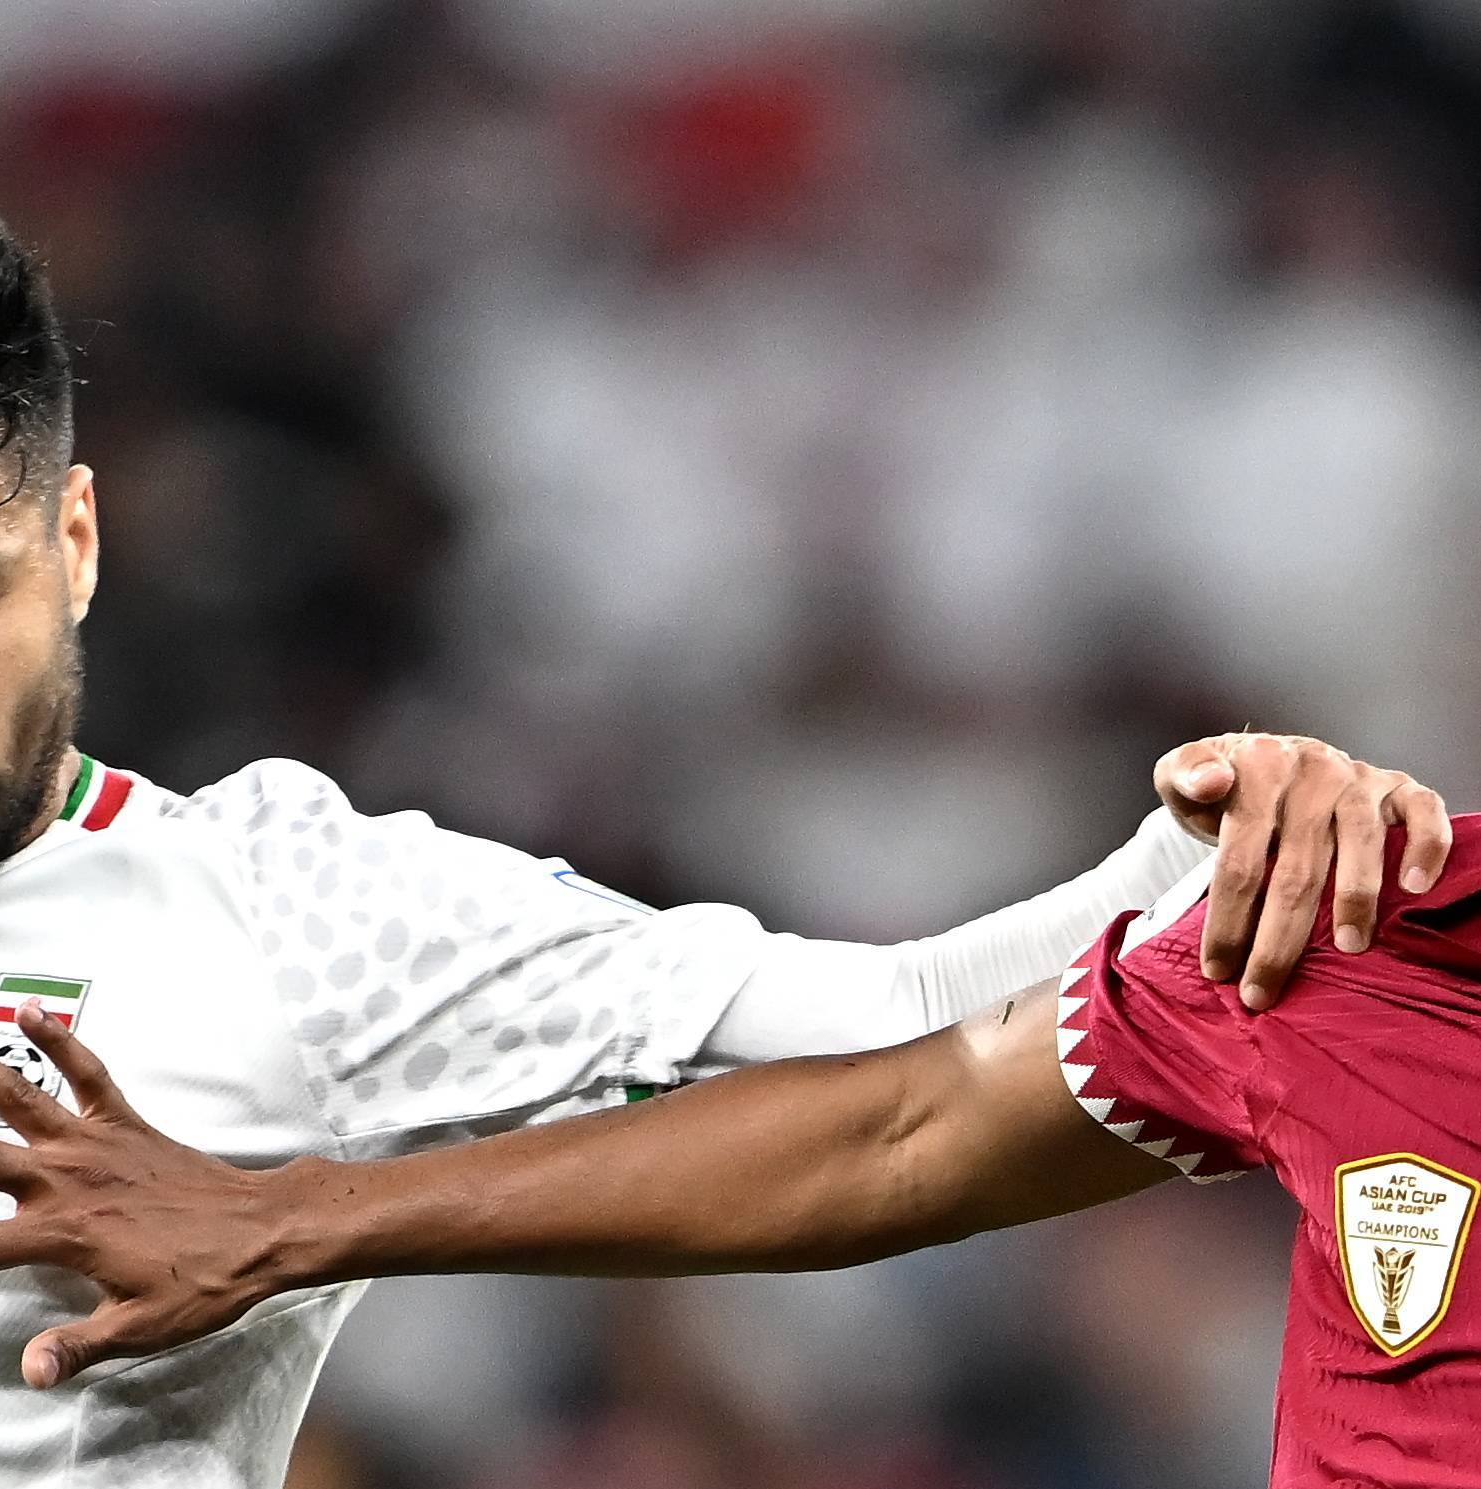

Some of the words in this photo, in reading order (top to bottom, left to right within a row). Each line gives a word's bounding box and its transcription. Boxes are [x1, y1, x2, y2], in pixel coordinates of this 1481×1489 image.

[1389, 1174, 1417, 1188] AFC
[1359, 1184, 1408, 1201] ASIAN
[1411, 1190, 1448, 1205] CUP
[1371, 1201, 1393, 1213] UAE
[1357, 1220, 1440, 1241] CHAMPIONS
